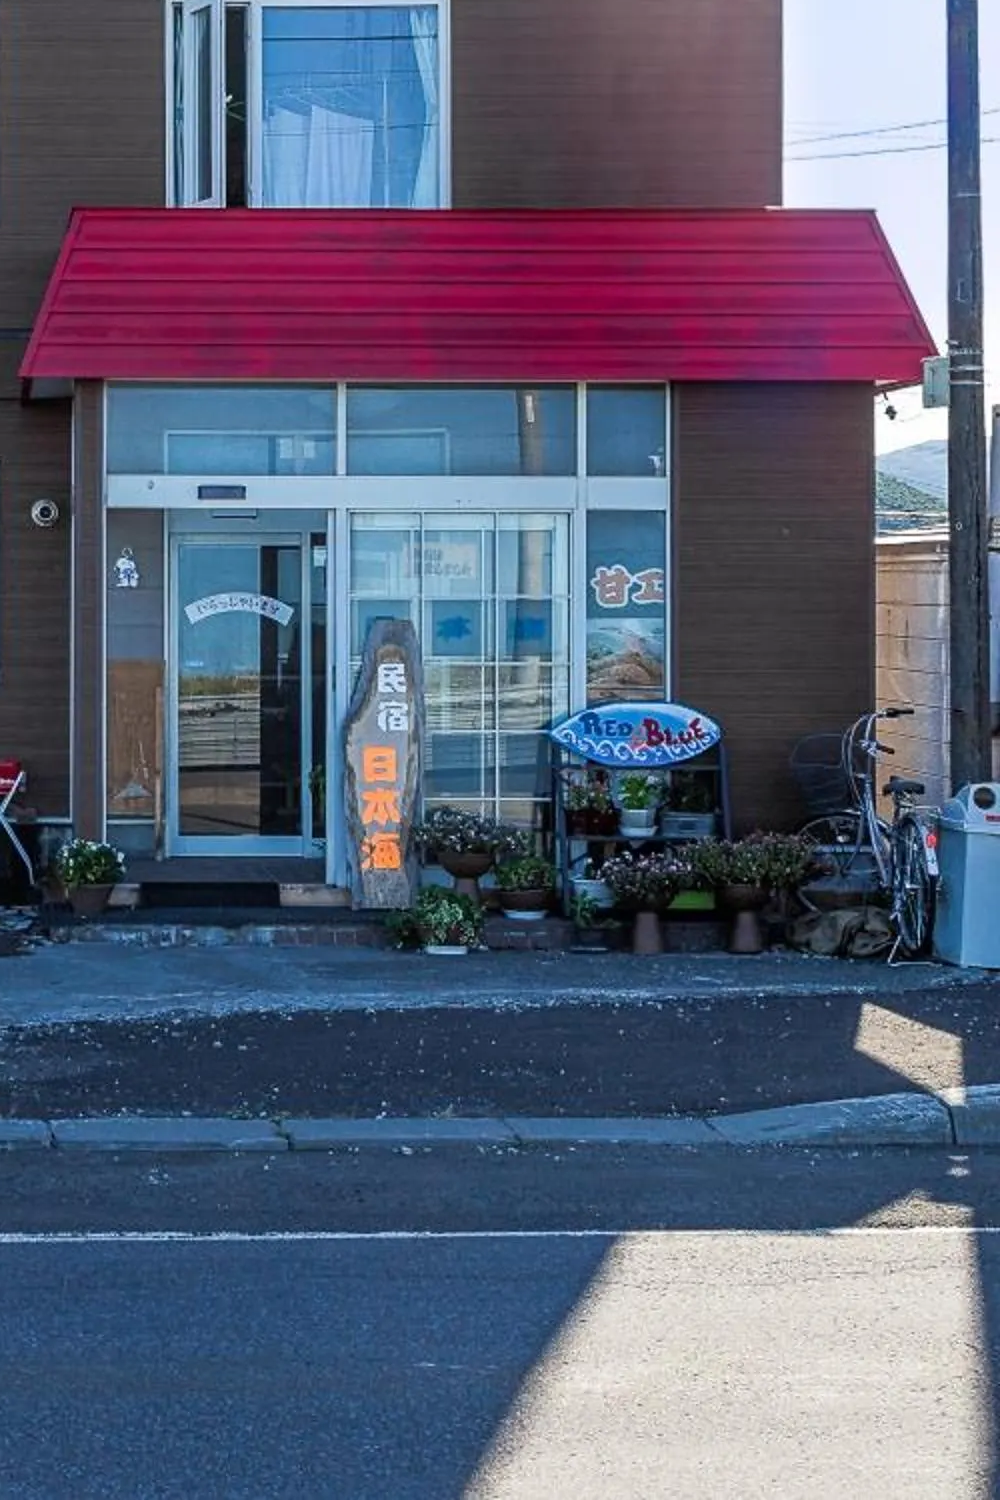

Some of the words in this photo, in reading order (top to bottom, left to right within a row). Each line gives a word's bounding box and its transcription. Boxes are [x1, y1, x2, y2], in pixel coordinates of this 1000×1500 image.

[377, 663, 408, 732] 民宿
[579, 711, 634, 738] RED
[643, 717, 705, 747] BLUE
[361, 745, 401, 870] 日本海
